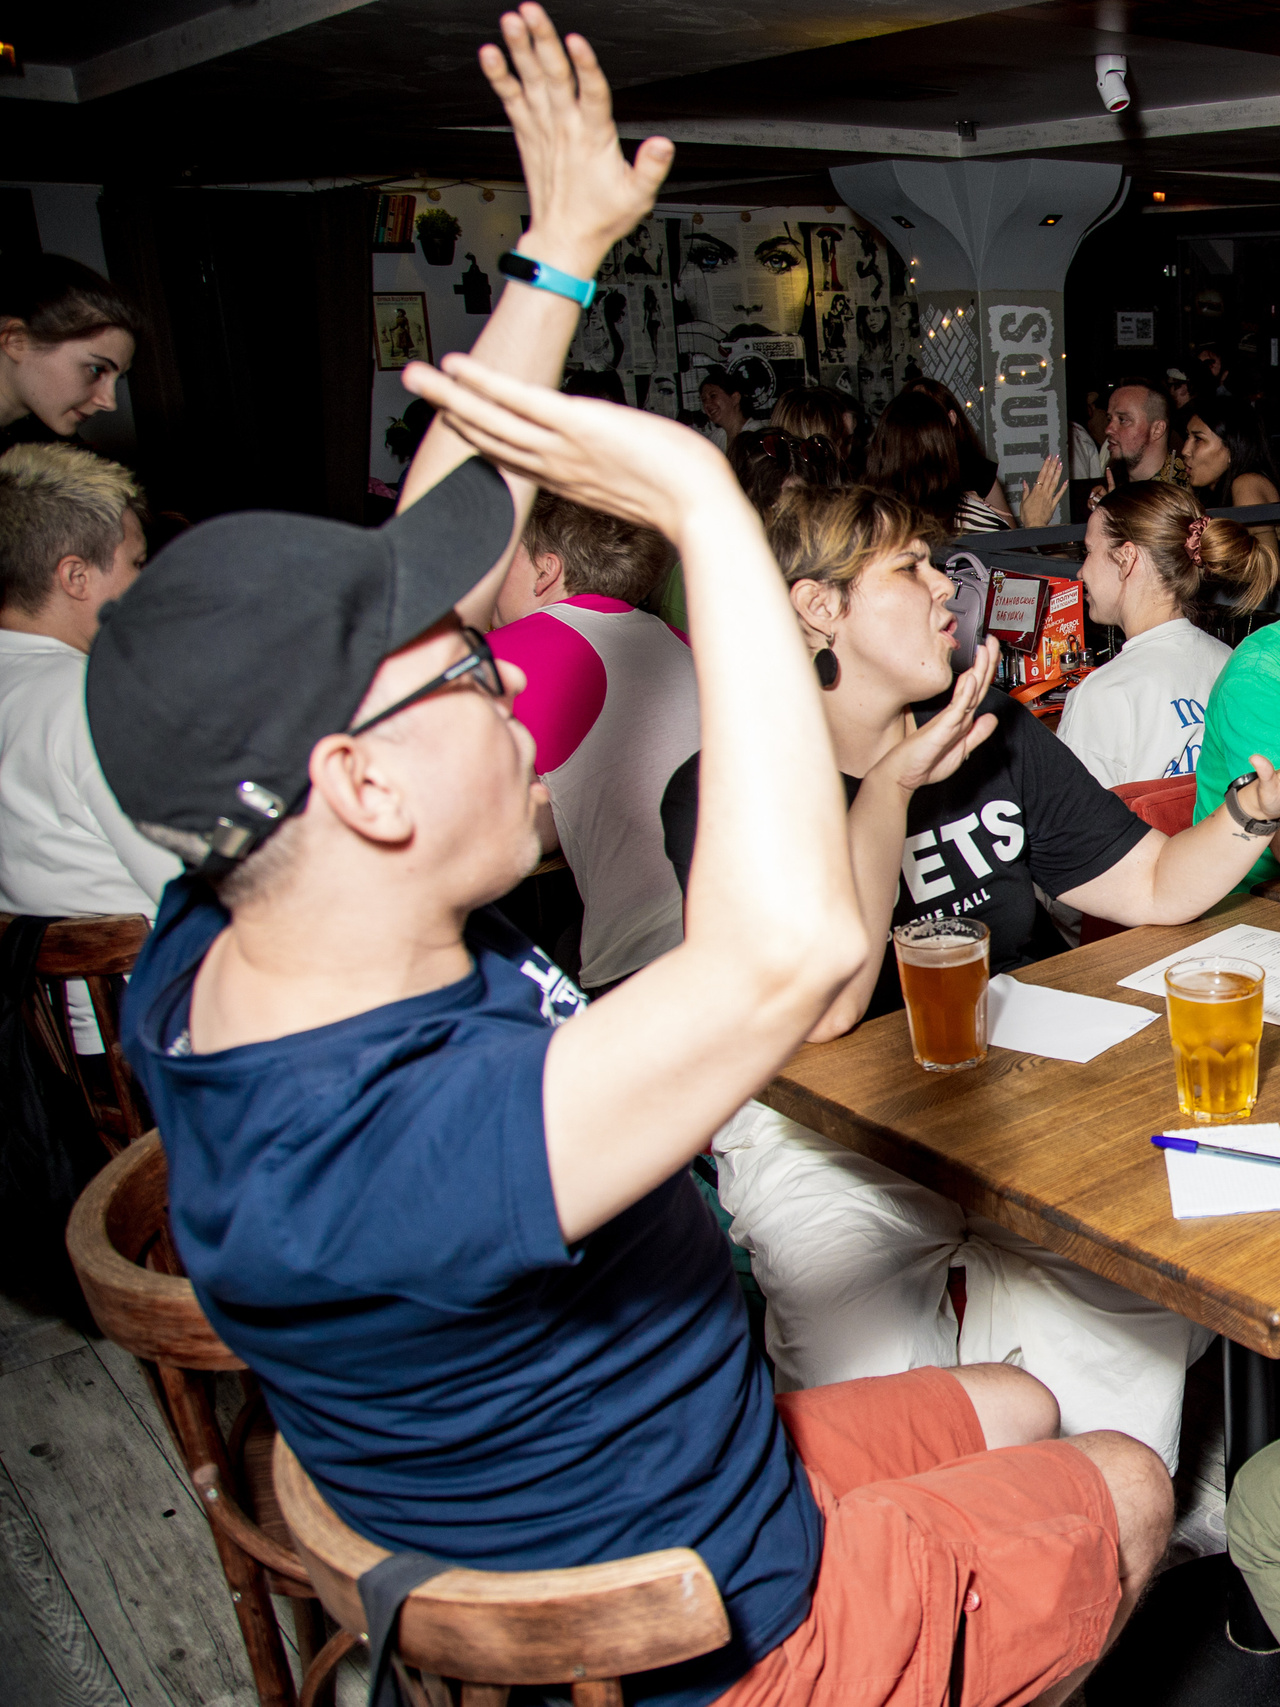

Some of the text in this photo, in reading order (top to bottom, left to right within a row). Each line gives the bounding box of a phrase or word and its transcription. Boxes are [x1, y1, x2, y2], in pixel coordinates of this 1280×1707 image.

[994, 595, 1036, 606] БУЛАНОВСКИЕ
[996, 610, 1025, 622] БАБУШКИ
[1060, 619, 1080, 633] APEROL
[893, 800, 1025, 908] ETS
[952, 888, 992, 916] FALL
